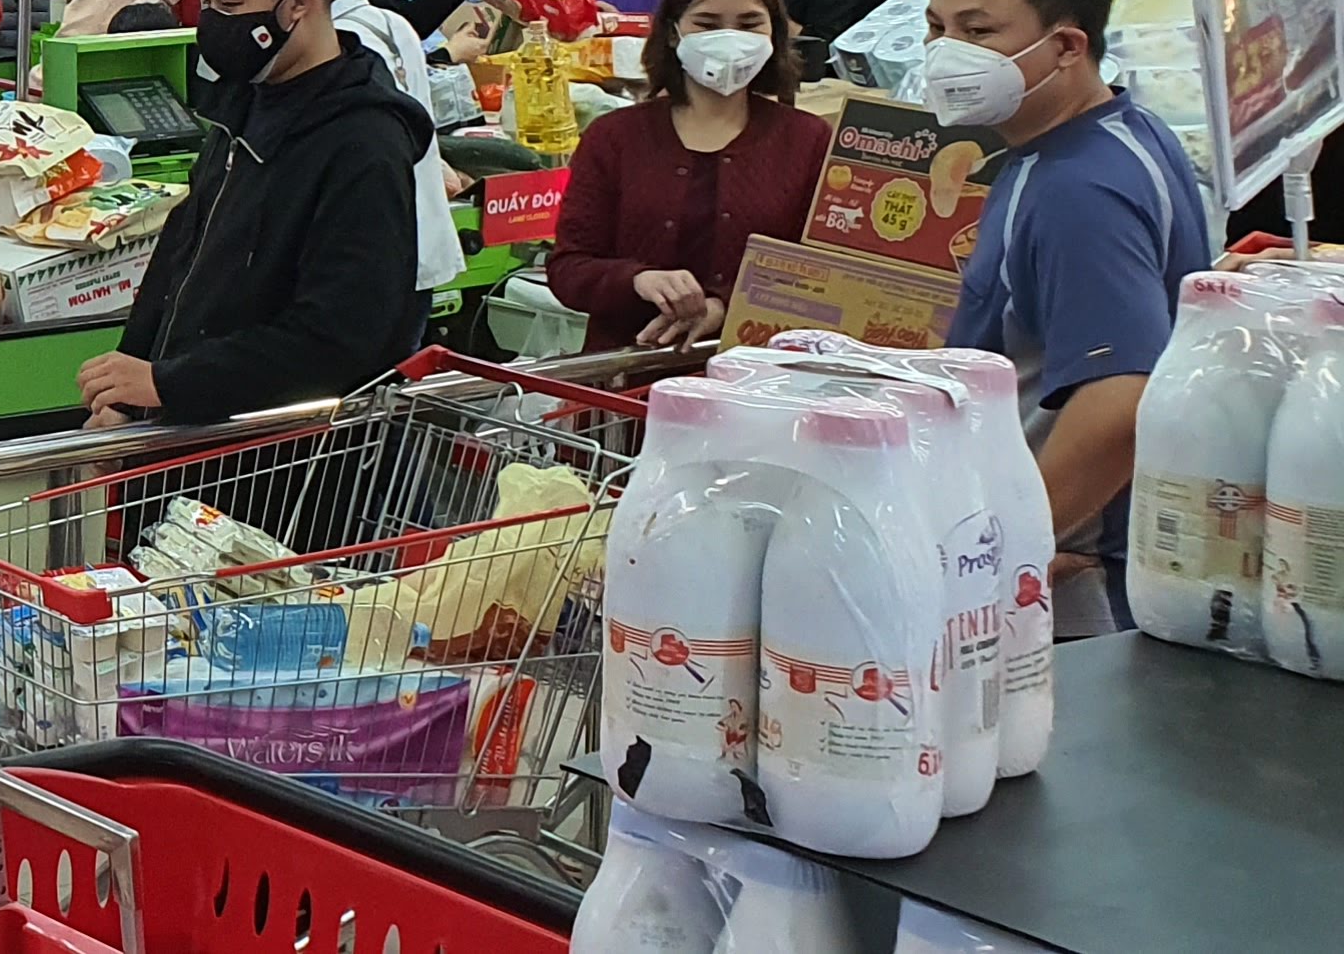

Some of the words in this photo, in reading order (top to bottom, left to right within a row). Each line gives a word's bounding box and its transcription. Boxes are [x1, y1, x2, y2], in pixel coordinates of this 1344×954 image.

[838, 125, 924, 162] Omachi
[531, 188, 562, 209] ĐÓN
[881, 212, 897, 226] 45
[899, 219, 908, 231] g
[92, 285, 111, 299] HAI
